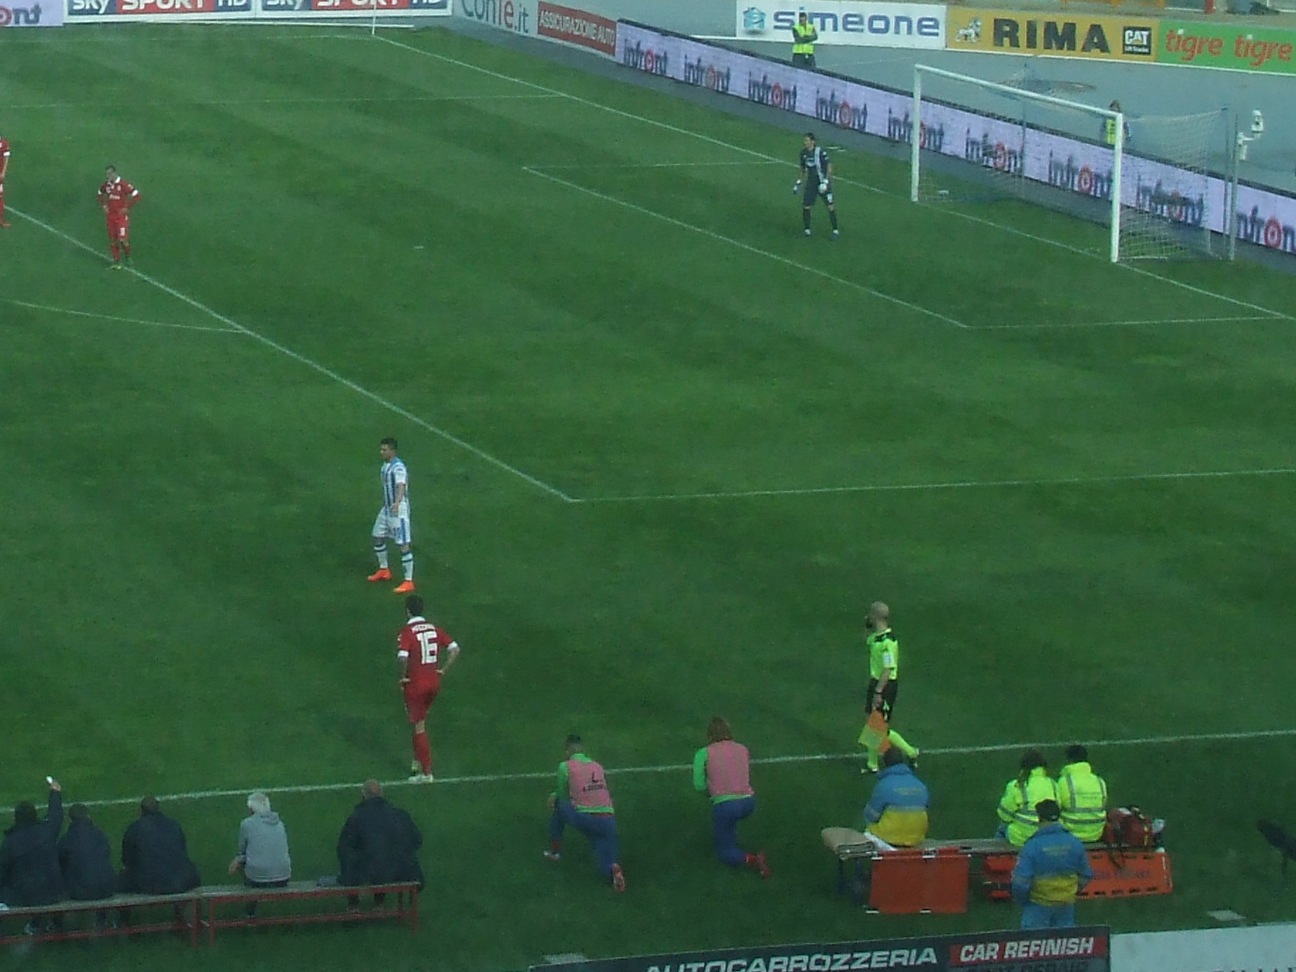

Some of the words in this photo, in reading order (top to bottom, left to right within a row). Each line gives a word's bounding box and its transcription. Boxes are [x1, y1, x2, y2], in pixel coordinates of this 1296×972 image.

[773, 5, 940, 38] smeone
[993, 17, 1112, 54] RIMA
[1124, 29, 1150, 46] CAT
[624, 38, 668, 75] infront
[1165, 28, 1224, 61] tigre
[1234, 34, 1293, 67] tigre
[684, 54, 730, 92] infront
[748, 70, 797, 111] infront
[815, 87, 868, 132] infront
[1232, 204, 1296, 253] nfron
[417, 632, 438, 664] 16
[960, 942, 1000, 962] CAR
[1004, 937, 1096, 959] REFINISH
